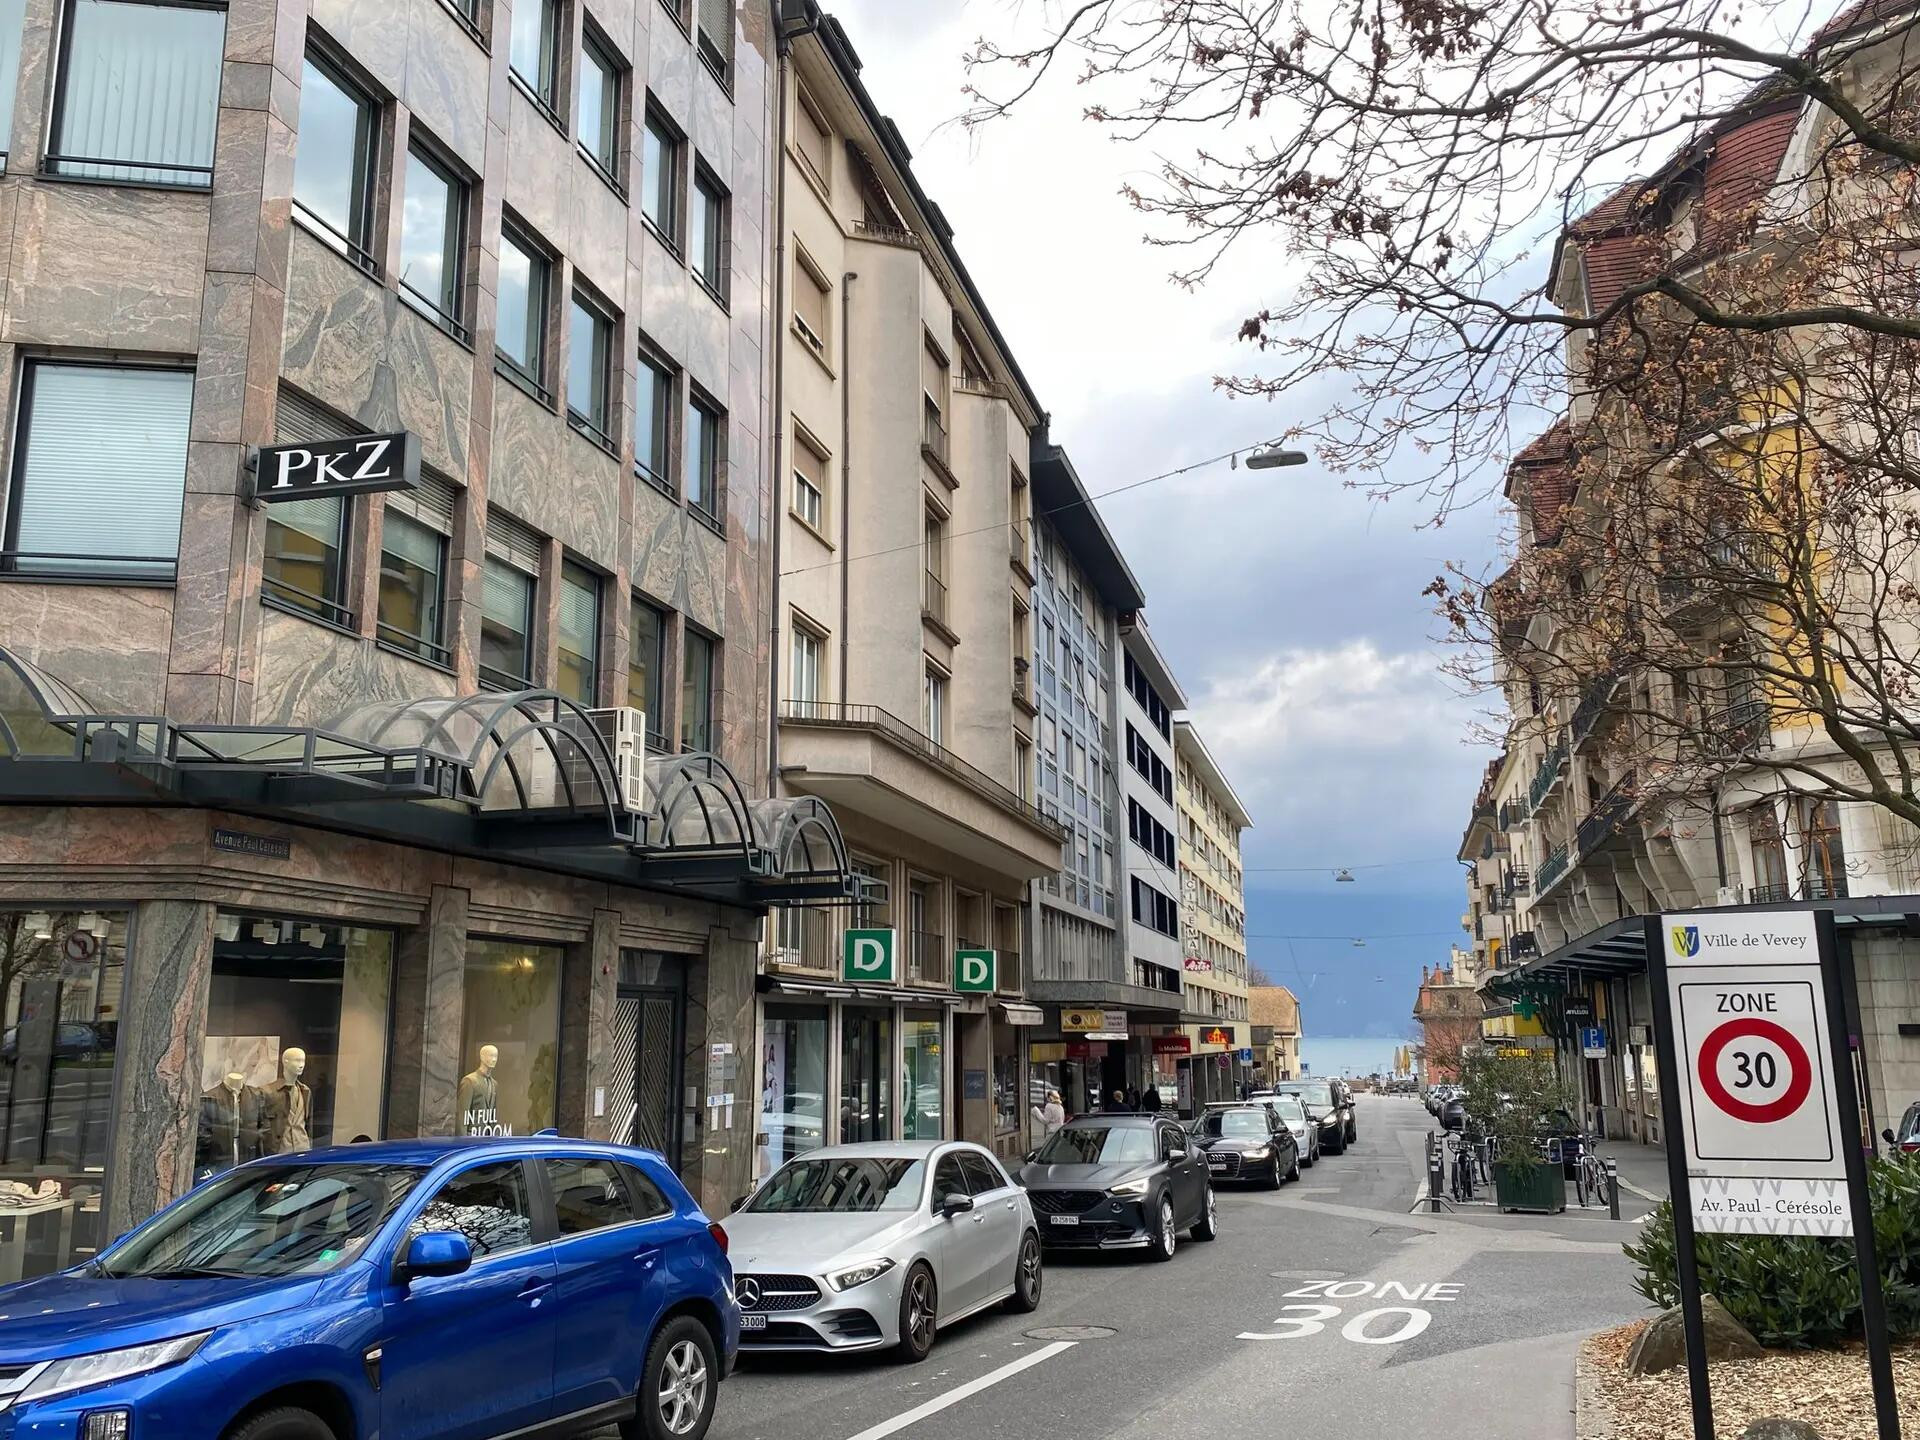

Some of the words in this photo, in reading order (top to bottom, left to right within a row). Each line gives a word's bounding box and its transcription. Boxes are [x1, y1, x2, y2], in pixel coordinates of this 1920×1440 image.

[271, 439, 391, 488] PKZ
[215, 832, 241, 847] Avenue
[243, 835, 258, 849] Paul
[1186, 880, 1198, 949] CINEMA
[1704, 933, 1738, 947] Ville
[1742, 933, 1760, 946] de
[1762, 933, 1808, 949] Vevey
[854, 938, 885, 972] D
[962, 957, 988, 985] D
[1715, 993, 1778, 1012] ZONE
[1732, 1051, 1777, 1089] 30
[463, 1109, 475, 1126] IN
[477, 1108, 498, 1124] FULL
[1700, 1198, 1723, 1211] Av.
[1728, 1198, 1761, 1212] Paul
[1775, 1199, 1843, 1215] Cérésole
[1281, 1280, 1466, 1301] ZONE
[1235, 1304, 1432, 1345] 30
